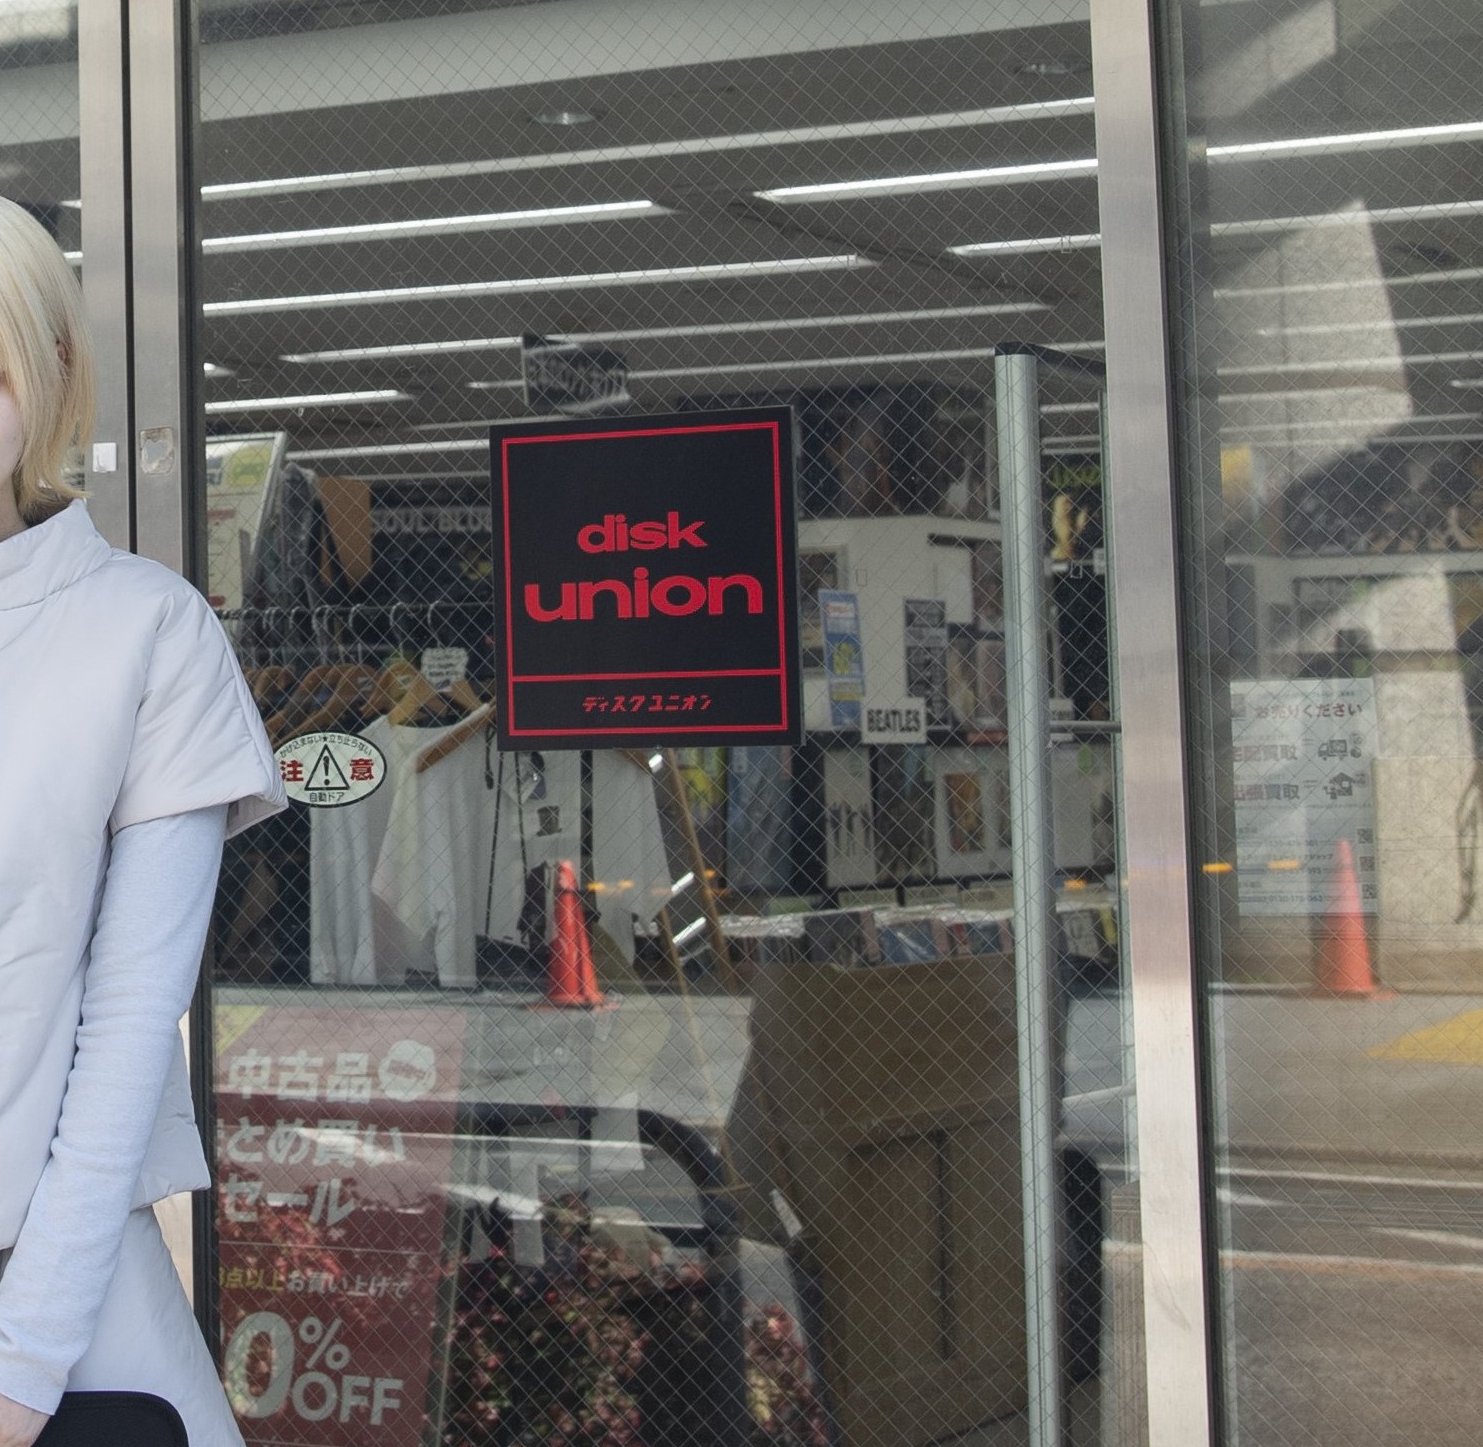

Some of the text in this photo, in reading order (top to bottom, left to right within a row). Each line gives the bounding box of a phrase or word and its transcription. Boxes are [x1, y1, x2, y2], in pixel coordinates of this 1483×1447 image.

[577, 511, 707, 554] disk
[524, 567, 764, 623] union
[582, 694, 712, 713] ディスクユニオン
[866, 708, 921, 733] BEATLES
[227, 1048, 373, 1104] 中古品
[223, 1173, 356, 1227] セール
[291, 1370, 404, 1426] OFF
